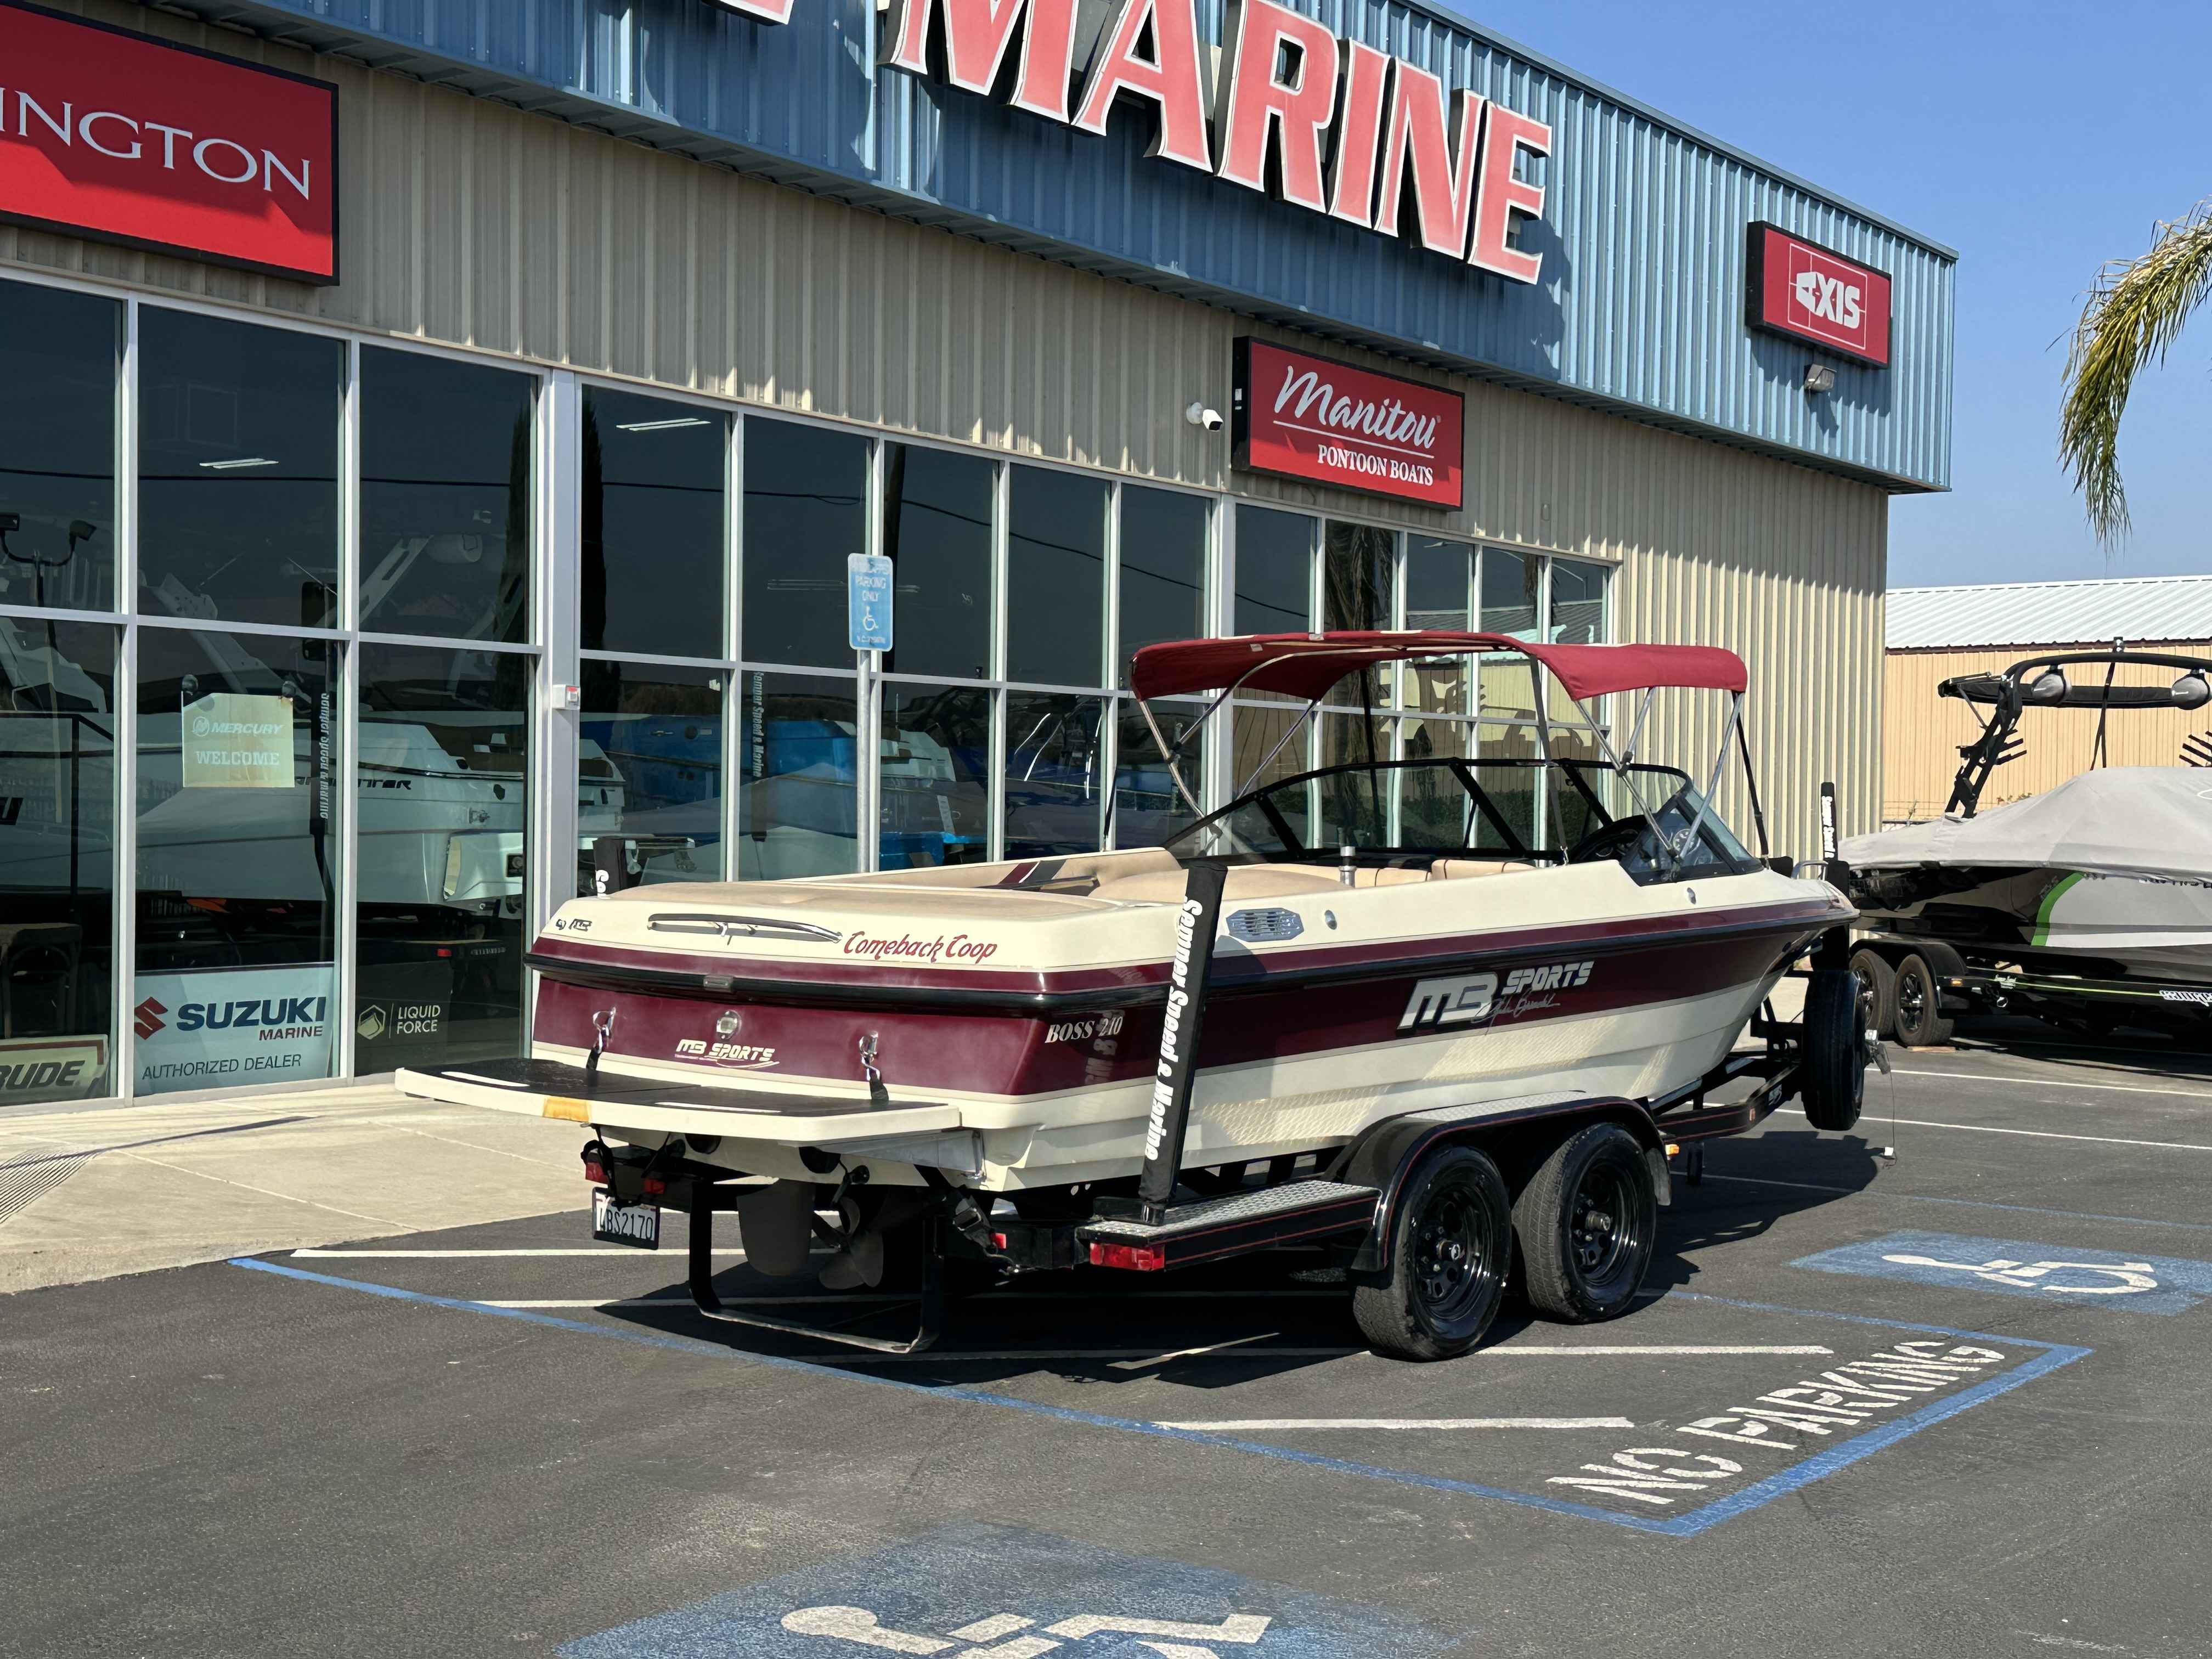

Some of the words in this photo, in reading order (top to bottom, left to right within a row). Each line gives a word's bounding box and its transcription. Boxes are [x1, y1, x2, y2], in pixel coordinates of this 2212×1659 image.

[878, 0, 1553, 286] MARINE
[1796, 272, 1860, 329] AXIS
[1274, 365, 1437, 449] Manitou
[1317, 444, 1388, 476] PONTOON
[1390, 460, 1434, 486] BOATS
[212, 722, 285, 735] MERCURY
[195, 751, 280, 765] WELCOME
[844, 931, 944, 963] Comeback
[945, 934, 998, 964] Coop
[398, 1005, 441, 1019] LIQUID
[1396, 972, 1498, 1030] MB
[1501, 961, 1594, 995] SPORTS
[177, 996, 326, 1031] SUZUKI
[397, 1019, 438, 1035] FORCE
[1044, 1020, 1095, 1043] BOSS
[1098, 1016, 1124, 1037] 210
[258, 1025, 323, 1041] MARINE
[142, 1058, 239, 1080] AUTHORIZED
[244, 1054, 302, 1071] DEALER
[708, 1042, 776, 1062] SPORTS
[1144, 1079, 1174, 1161] Marine
[1545, 1447, 1743, 1505] NO
[1676, 1341, 2005, 1450] PARKING
